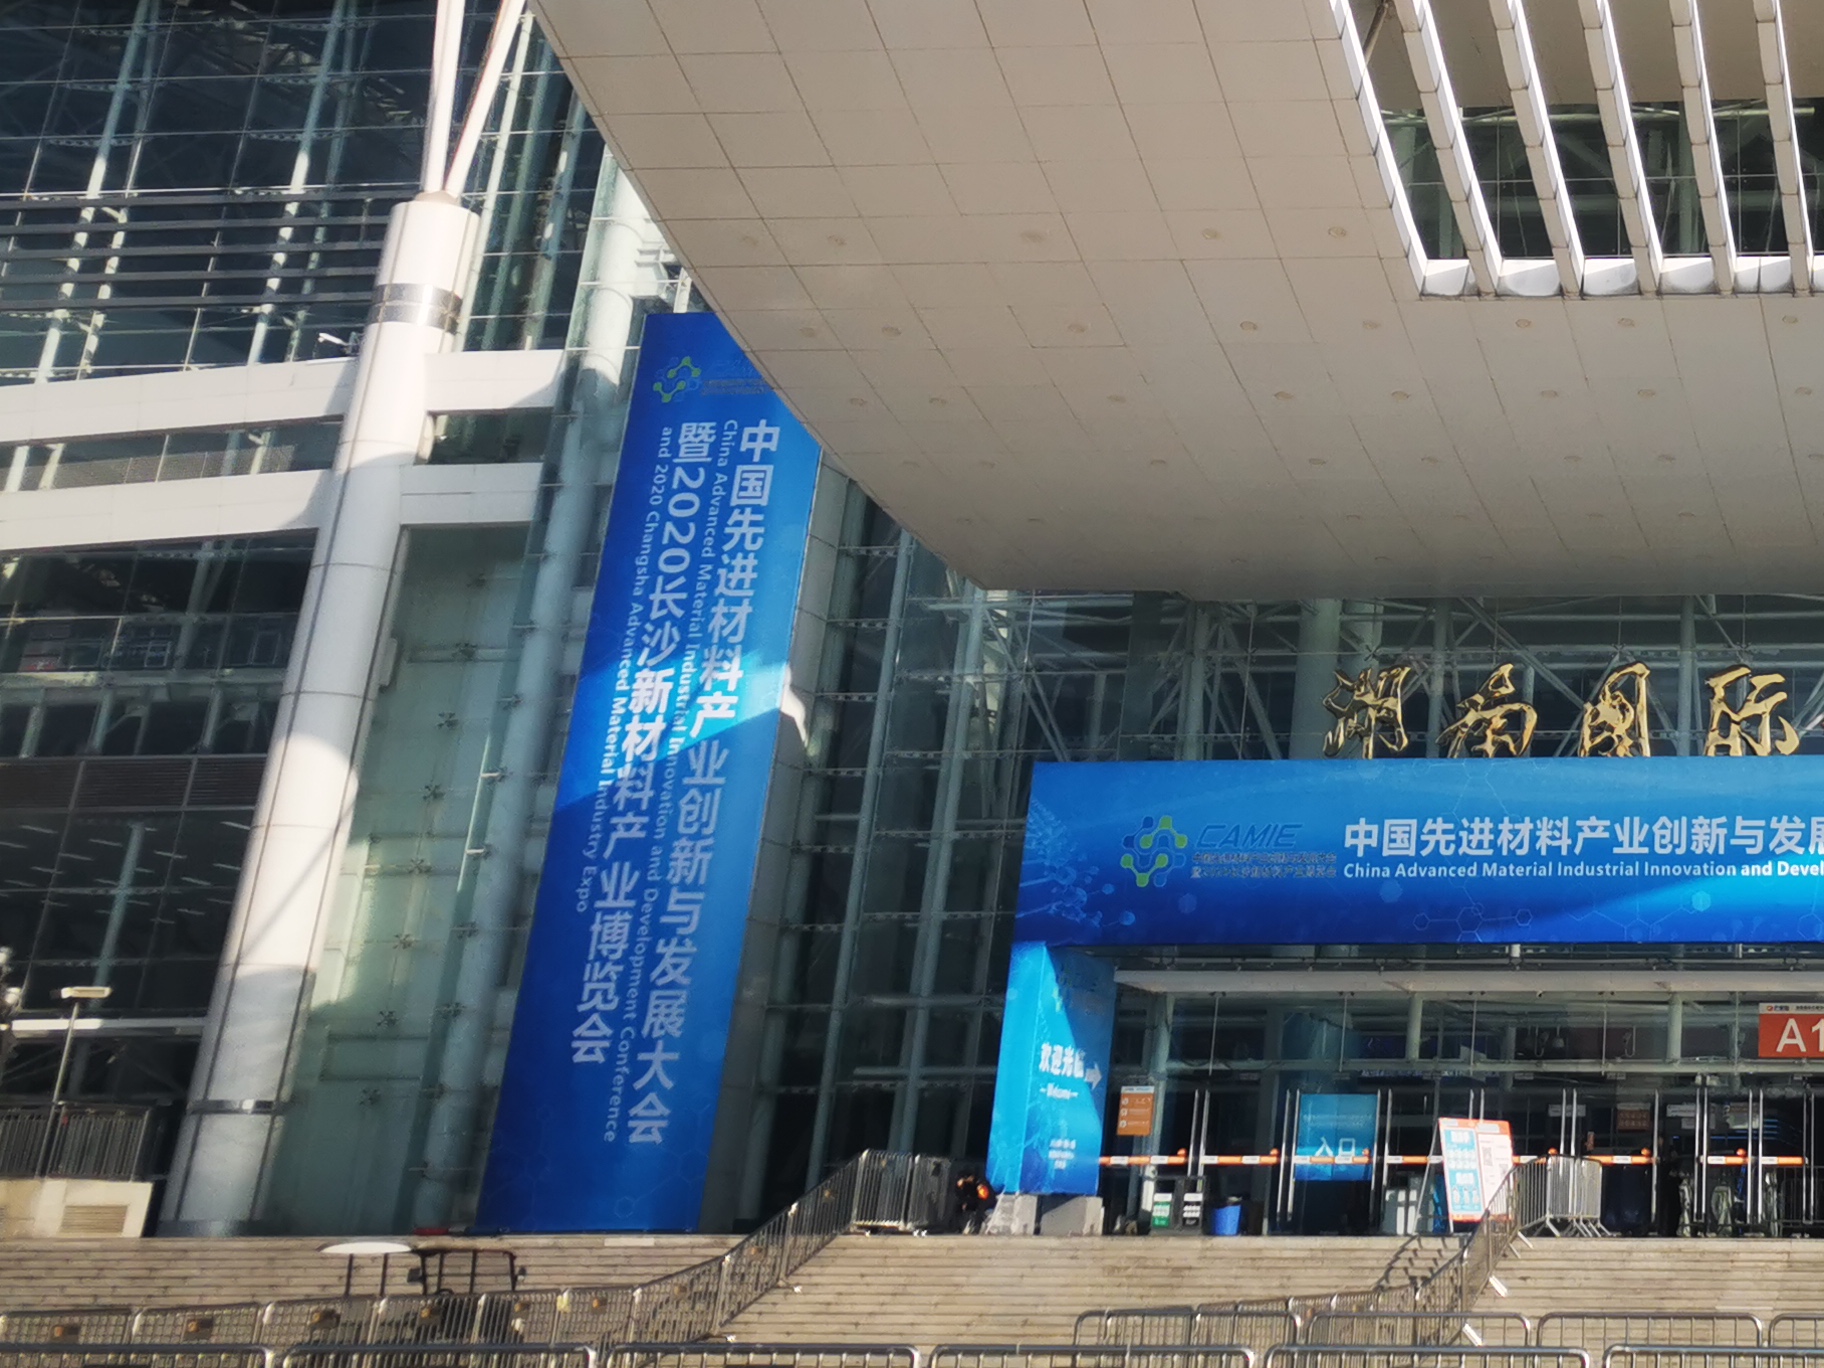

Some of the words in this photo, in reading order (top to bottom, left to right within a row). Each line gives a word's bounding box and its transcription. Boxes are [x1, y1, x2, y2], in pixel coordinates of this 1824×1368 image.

[658, 426, 672, 459] and
[716, 419, 738, 468] China
[649, 464, 669, 506] 2020
[701, 472, 727, 559] Advanced
[633, 510, 660, 596] Changsha
[687, 563, 711, 637] Material
[615, 602, 643, 691] Advanced
[673, 643, 698, 732] Industrial
[571, 422, 716, 1064] 暨2020长沙新材料产业博览会
[601, 697, 628, 775] Material
[582, 779, 614, 860] Industry
[627, 419, 780, 1145] 中国先进材料产业创新与发展大会
[653, 736, 686, 840] Innovation
[646, 845, 664, 882] and
[1195, 823, 1302, 848] CAMIE
[1343, 863, 1390, 878] China
[1395, 862, 1478, 877] Advanced
[1482, 861, 1552, 877] Material
[1558, 860, 1639, 876] Industrial
[1645, 860, 1737, 876] Innovation
[1741, 860, 1773, 876] and
[576, 865, 598, 913] Expo
[623, 887, 658, 1021] Development
[1776, 1018, 1824, 1053] A1
[604, 1027, 635, 1142] Conference
